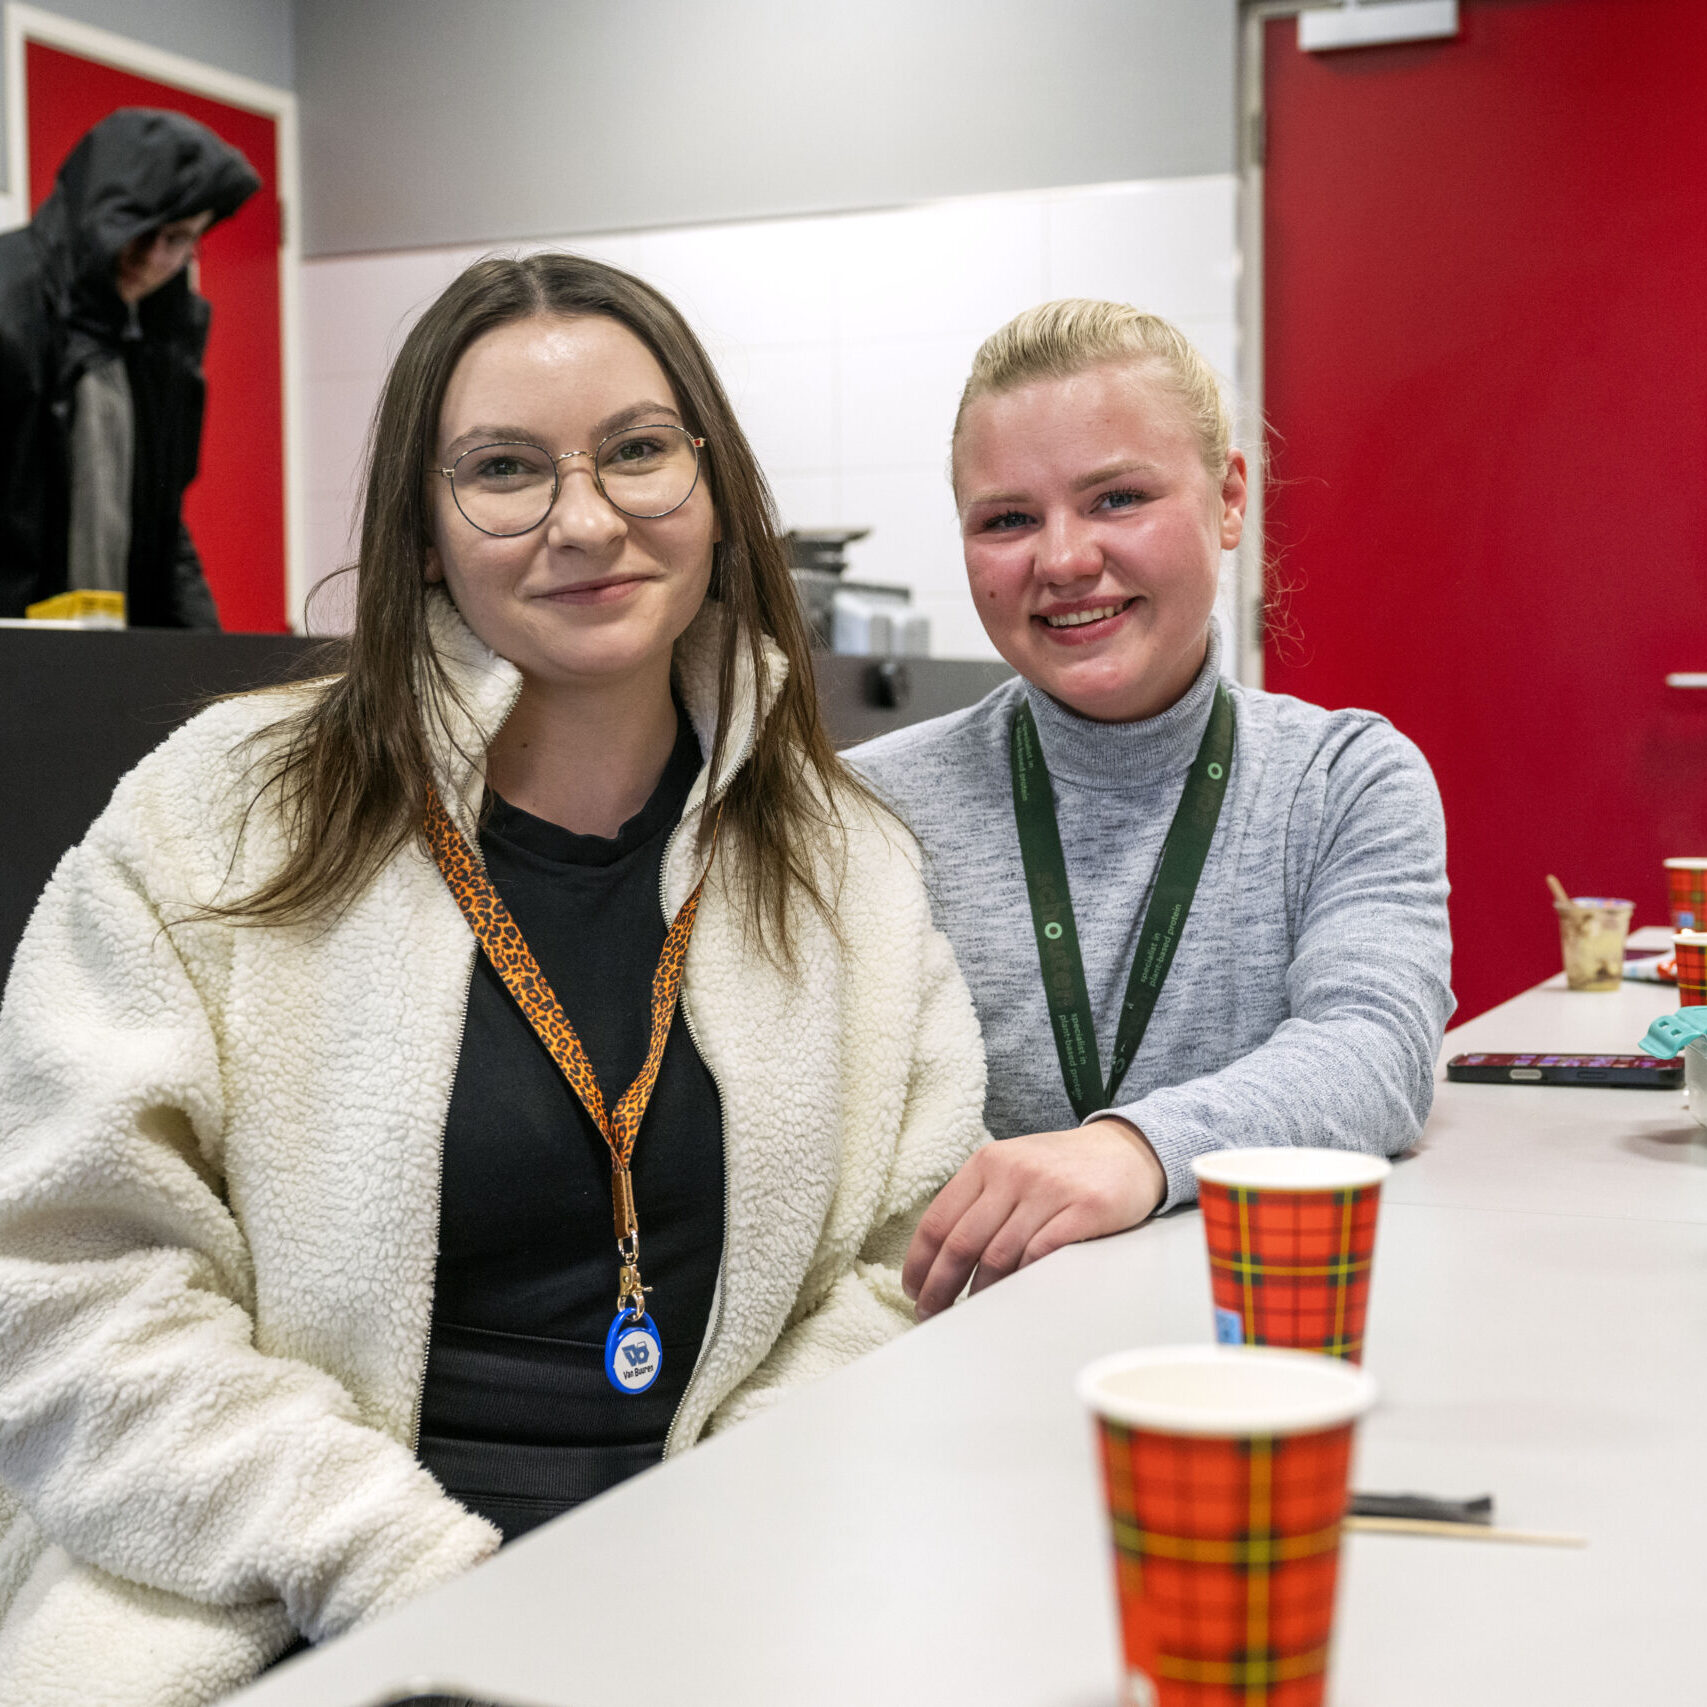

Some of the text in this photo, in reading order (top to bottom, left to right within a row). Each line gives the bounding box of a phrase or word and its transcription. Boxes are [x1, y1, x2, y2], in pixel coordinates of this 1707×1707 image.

[1140, 933, 1161, 983] specialist in
[1149, 904, 1182, 987] plant-based protein
[1058, 1015, 1084, 1101] plant-based protein
[1070, 1013, 1088, 1065] specialist in
[623, 1364, 654, 1380] Van Buuren
